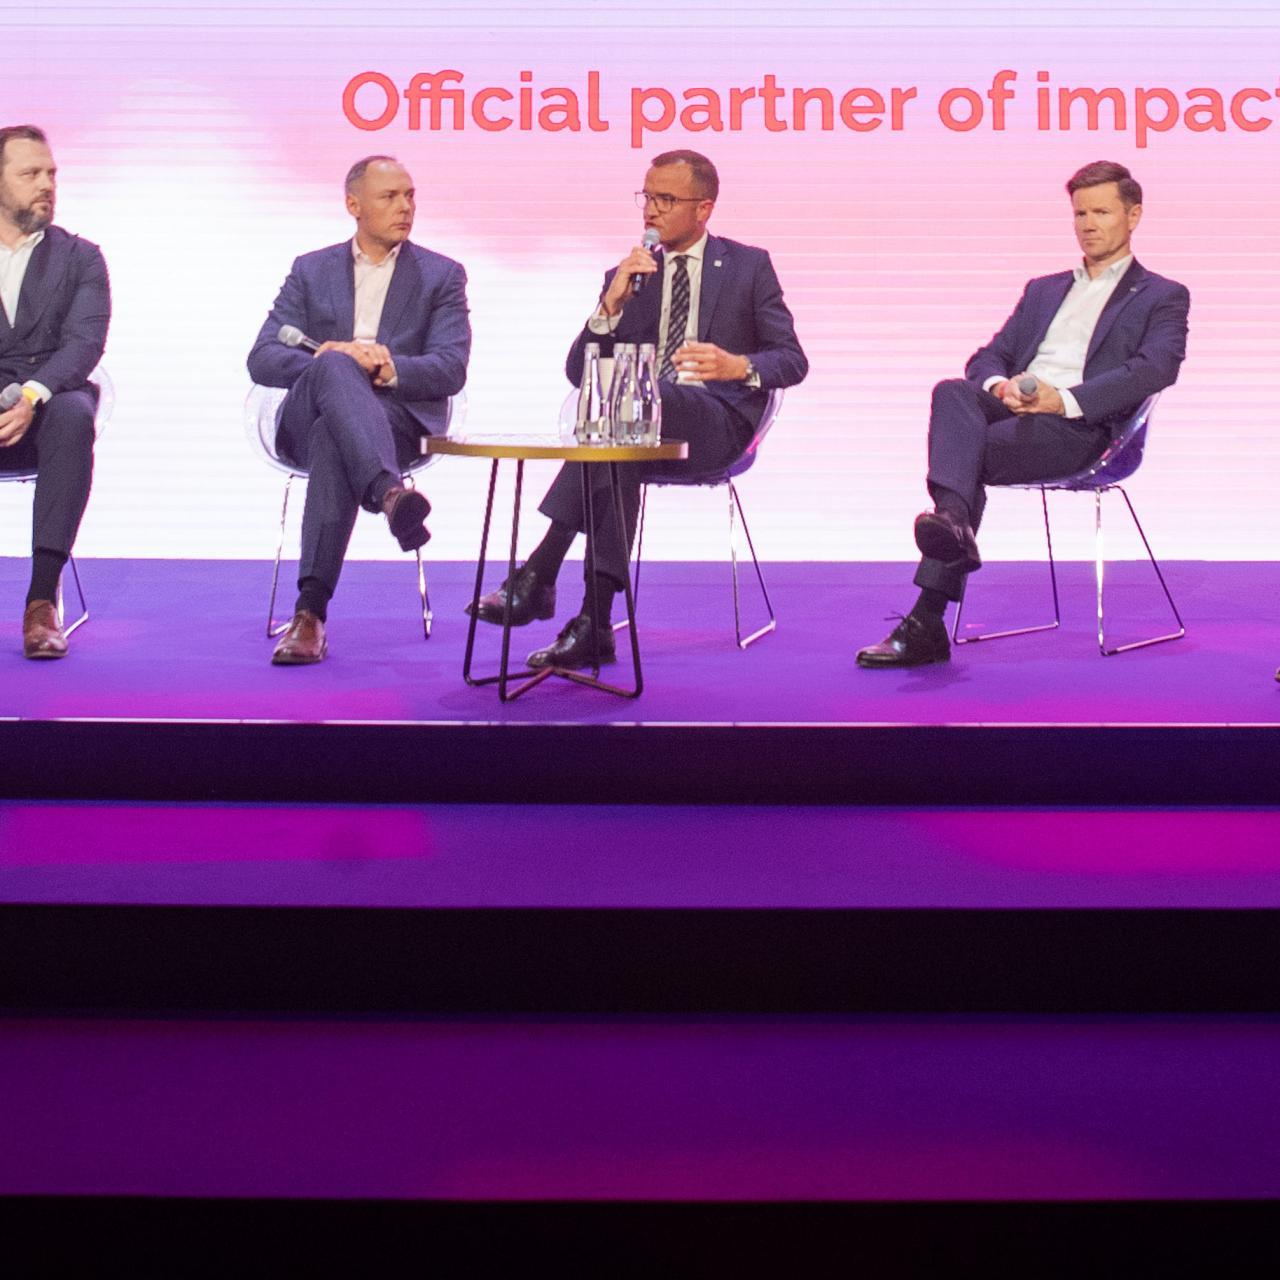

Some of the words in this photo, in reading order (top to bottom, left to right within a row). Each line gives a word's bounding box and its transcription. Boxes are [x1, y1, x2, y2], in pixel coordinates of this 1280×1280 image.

[342, 69, 610, 133] Official
[630, 74, 918, 149] partner
[937, 69, 1018, 133] of
